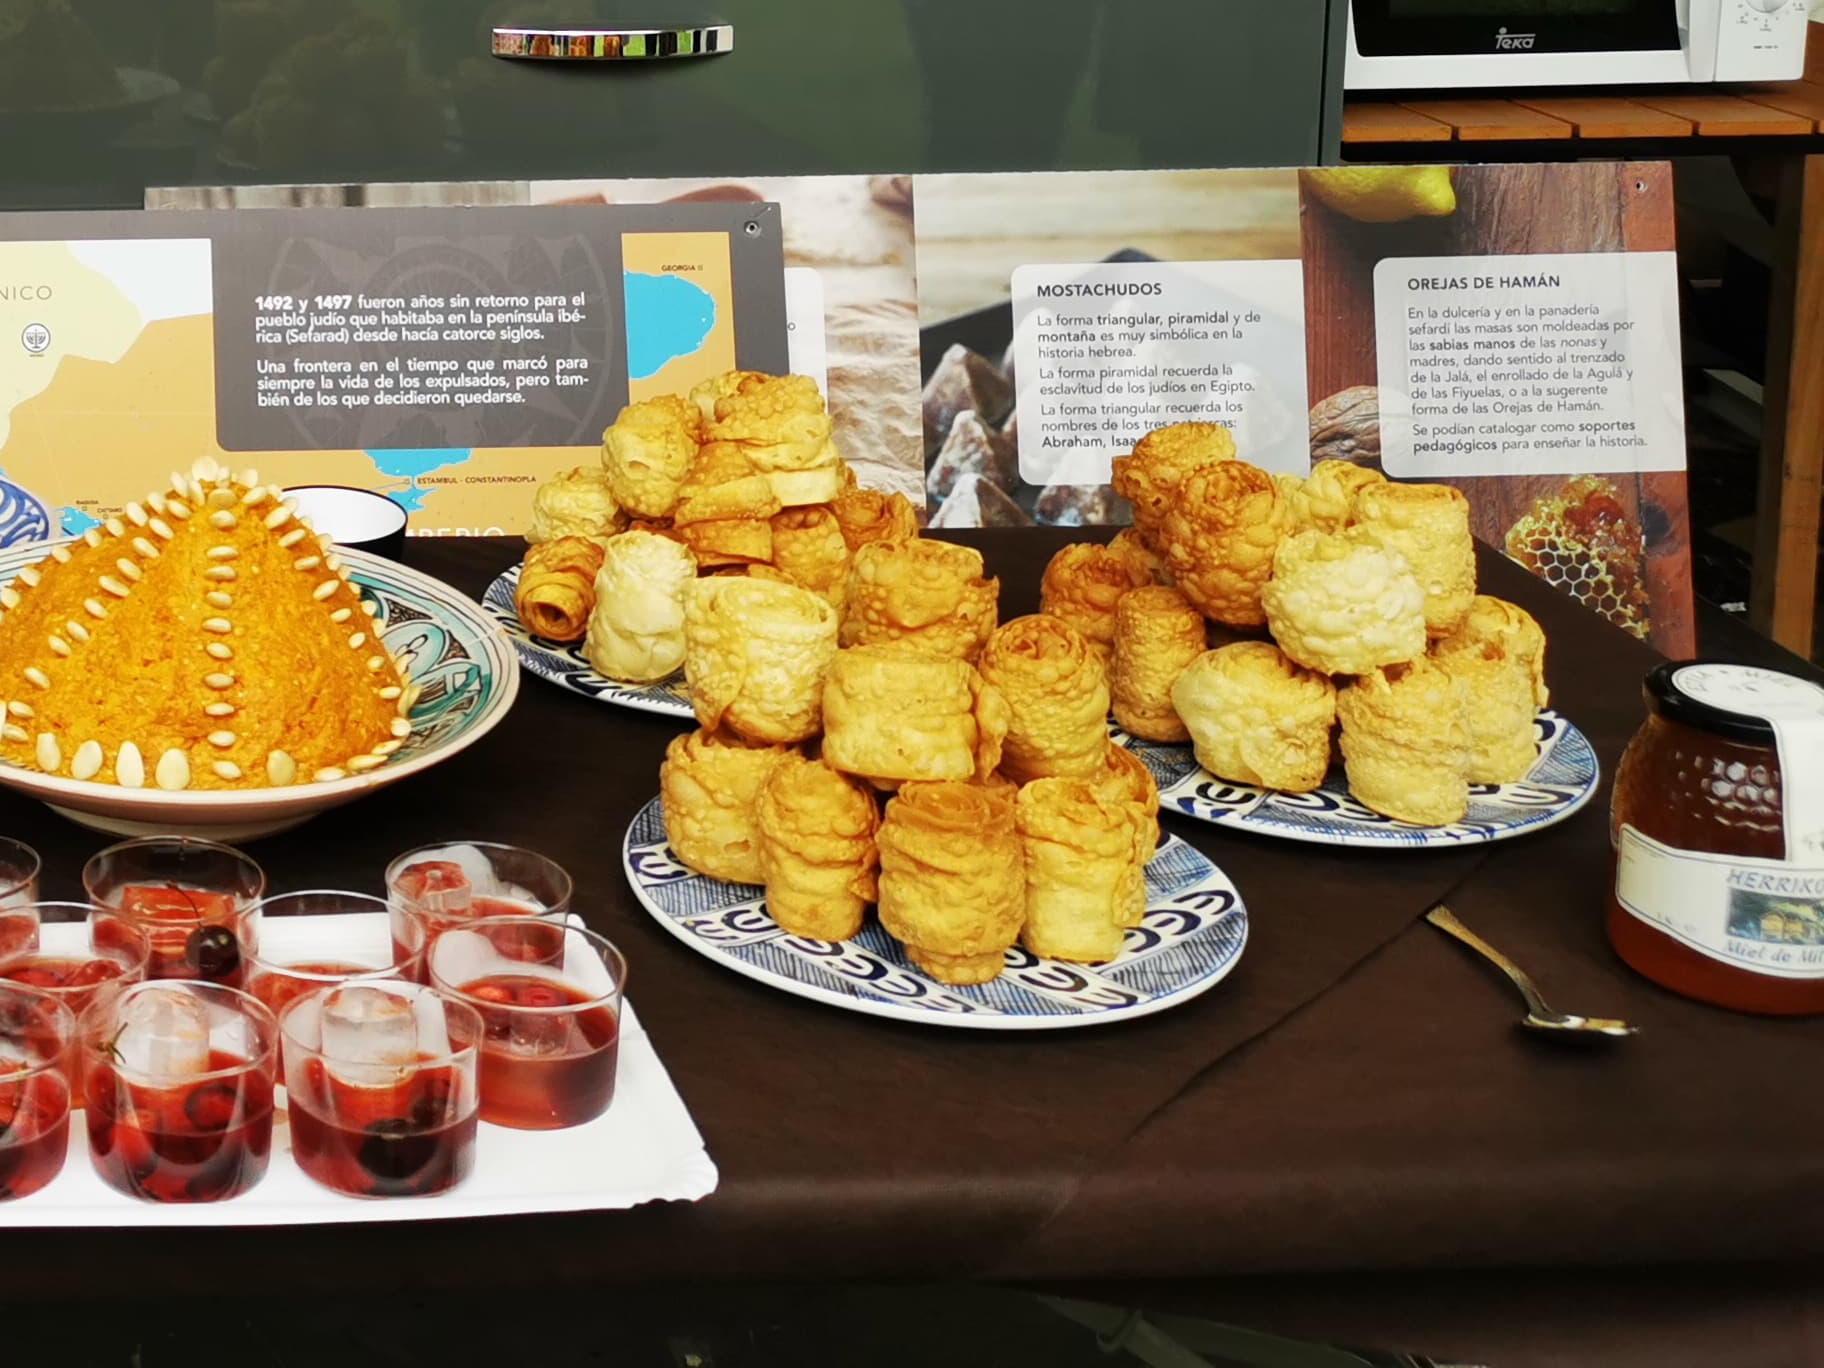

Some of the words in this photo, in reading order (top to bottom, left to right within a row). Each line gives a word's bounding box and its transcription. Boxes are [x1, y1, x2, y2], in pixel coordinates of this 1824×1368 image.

[661, 264, 696, 272] GEORGIA
[1037, 283, 1162, 297] MOSTACHUDOS
[1407, 277, 1468, 290] OREJAS
[1473, 276, 1494, 289] DE
[1499, 273, 1560, 289] HAMÁN
[255, 295, 293, 311] 1492
[298, 299, 308, 314] y
[314, 294, 352, 310] 1497
[357, 294, 405, 310] fueron
[410, 293, 444, 309] años
[449, 294, 469, 308] sin
[475, 293, 529, 308] retorno
[534, 296, 566, 311] para
[571, 291, 585, 307] el
[255, 311, 306, 331] pueblo
[310, 310, 346, 330] judío
[349, 314, 378, 330] que
[381, 309, 444, 325] habitaba
[447, 313, 466, 325] en
[470, 309, 482, 324] la
[486, 308, 553, 328] península
[558, 307, 586, 323] ibé-
[1037, 313, 1051, 326] La
[1055, 313, 1093, 326] forma
[1096, 312, 1163, 329] triangular,
[1167, 311, 1228, 328] piramidal
[1233, 314, 1240, 327] y
[1244, 310, 1260, 323] de
[1408, 306, 1424, 319] En
[1427, 305, 1438, 318] la
[1494, 308, 1501, 321] y
[1505, 307, 1520, 317] en
[1524, 304, 1535, 317] la
[1037, 328, 1096, 342] montaña
[1100, 332, 1114, 341] es
[1118, 331, 1145, 344] muy
[1149, 327, 1208, 340] simbólica
[1212, 330, 1228, 339] en
[1232, 326, 1242, 339] la
[1454, 321, 1471, 334] las
[1474, 324, 1513, 334] masas
[1516, 323, 1538, 333] son
[1542, 318, 1609, 333] moldeadas
[1613, 321, 1634, 335] por
[255, 329, 281, 344] rica
[285, 327, 349, 347] (Sefarad)
[352, 326, 398, 343] desde
[401, 326, 438, 342] hacía
[442, 326, 496, 341] catorce
[500, 325, 544, 345] siglos.
[1409, 338, 1425, 351] las
[1429, 337, 1469, 351] sabias
[1473, 340, 1515, 350] manos
[1519, 336, 1535, 349] de
[1539, 335, 1556, 349] las
[1560, 338, 1596, 348] nonas
[1599, 338, 1607, 351] y
[1038, 345, 1084, 359] historia
[1088, 344, 1136, 358] hebrea.
[256, 359, 285, 374] Una
[293, 357, 351, 373] frontera
[359, 360, 378, 372] en
[385, 356, 399, 372] el
[406, 356, 459, 376] tiempo
[466, 359, 495, 375] que
[502, 354, 548, 370] marcó
[555, 358, 588, 373] para
[1039, 365, 1054, 379] La
[1057, 365, 1095, 378] forma
[1099, 364, 1158, 381] piramidal
[1162, 363, 1218, 377] recuerda
[1222, 363, 1232, 376] la
[257, 375, 315, 394] siempre
[320, 373, 333, 389] la
[338, 373, 369, 389] vida
[374, 373, 393, 388] de
[399, 372, 420, 388] los
[425, 371, 510, 392] expulsados,
[515, 375, 550, 391] pero
[555, 371, 589, 386] tam-
[1039, 381, 1103, 395] esclavitud
[1106, 381, 1123, 394] de
[1127, 380, 1145, 394] los
[1149, 380, 1186, 397] judíos
[1190, 383, 1206, 393] en
[1210, 379, 1255, 396] Egipto.
[257, 390, 289, 406] bién
[293, 390, 313, 406] de
[316, 390, 338, 405] los
[341, 393, 370, 409] que
[373, 388, 450, 405] decidieron
[453, 387, 525, 408] quedarse.
[1040, 402, 1055, 415] La
[1059, 402, 1097, 415] forma
[1100, 401, 1161, 418] triangular
[1165, 400, 1221, 414] recuerda
[1225, 400, 1243, 413] los
[1041, 417, 1097, 431] nombres
[1101, 417, 1118, 430] de
[1121, 416, 1140, 429] los
[1041, 434, 1106, 451] Abraham,
[1111, 433, 1138, 447] Isaa
[417, 477, 458, 485] ESTAMBUL
[465, 476, 537, 484] CONSTANTINOPLA
[1727, 939, 1766, 960] Miel
[1771, 946, 1792, 963] de
